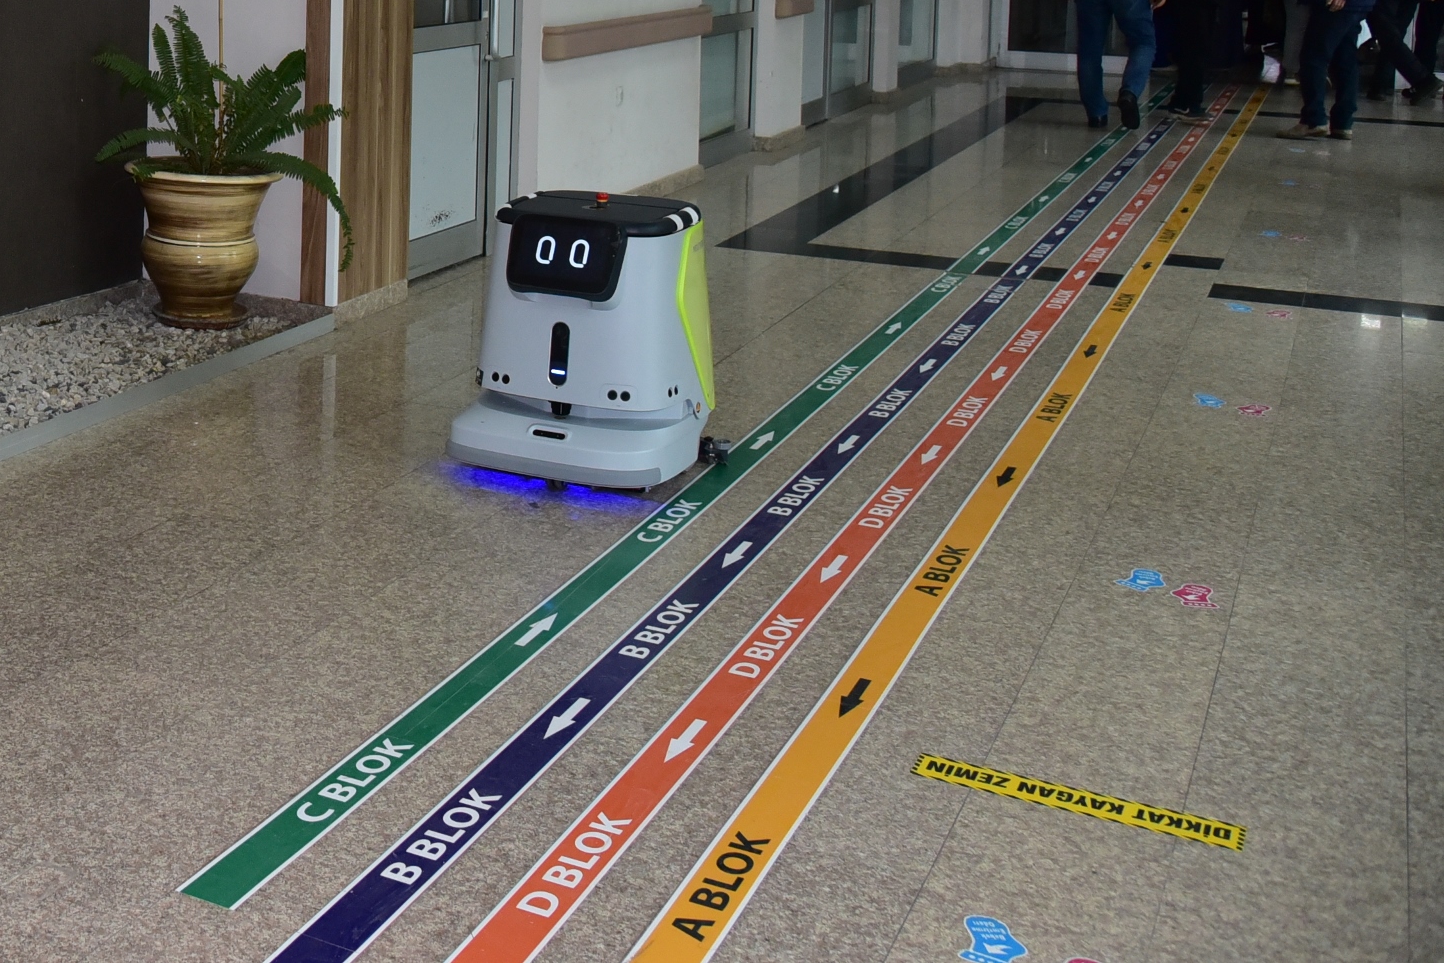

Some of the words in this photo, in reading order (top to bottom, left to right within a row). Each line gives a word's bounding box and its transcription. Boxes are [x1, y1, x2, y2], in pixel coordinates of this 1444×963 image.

[1045, 301, 1064, 310] D
[1053, 288, 1076, 305] BLOK
[941, 337, 960, 347] B
[951, 322, 977, 341] BLOK
[1008, 345, 1028, 354] D
[1017, 328, 1043, 348] BLOK
[816, 381, 836, 392] C
[830, 363, 860, 386] BLOK
[868, 407, 890, 419] B
[881, 387, 913, 413] BLOK
[955, 395, 989, 421] BLOK
[1036, 411, 1056, 423] A
[1041, 392, 1073, 417] BLOK
[946, 416, 968, 428] D
[767, 504, 794, 517] B
[783, 473, 824, 507] BLOK
[870, 484, 913, 518] BLOK
[636, 528, 663, 544] C
[650, 498, 702, 533] BLOK
[858, 515, 885, 530] D
[922, 544, 970, 584] BLOK
[914, 582, 944, 598] A
[619, 641, 652, 660] B
[638, 597, 699, 646] BLOK
[744, 613, 804, 662] BLOK
[728, 659, 762, 680] D
[296, 801, 334, 823] C
[318, 736, 415, 803] BLOK
[925, 758, 1011, 790] ZEMİN
[1016, 779, 1125, 816] KAYGAN
[380, 853, 423, 885] B
[406, 787, 502, 861] BLOK
[1132, 808, 1233, 842] DİKKAT
[516, 889, 560, 918] D
[541, 810, 632, 889] BLOK
[688, 830, 771, 912] BLOK
[671, 910, 715, 942] A
